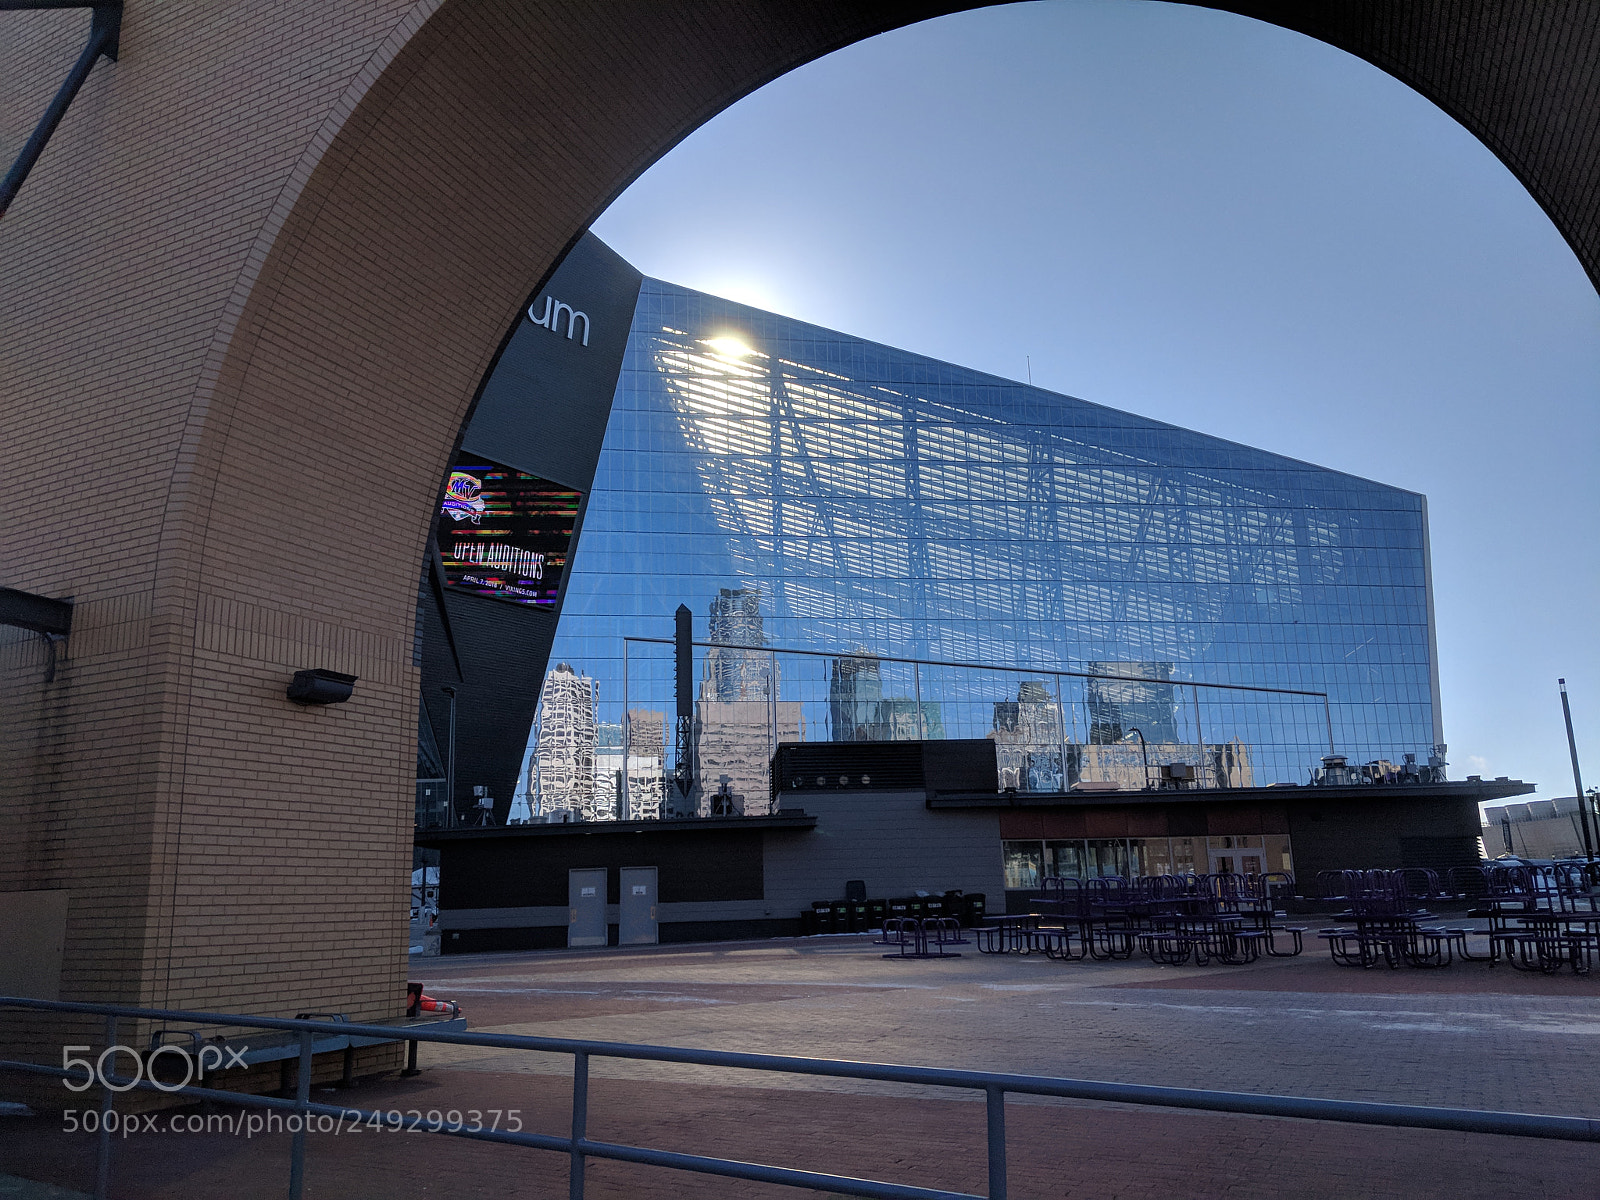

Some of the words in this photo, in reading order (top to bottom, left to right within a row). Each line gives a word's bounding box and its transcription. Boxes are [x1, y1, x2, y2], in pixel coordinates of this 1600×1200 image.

[527, 295, 590, 347] um
[453, 542, 485, 566] OPEN
[486, 542, 545, 580] AUDITIONS
[462, 574, 479, 584] APRIL
[505, 584, 538, 598] VIKINGS.COM
